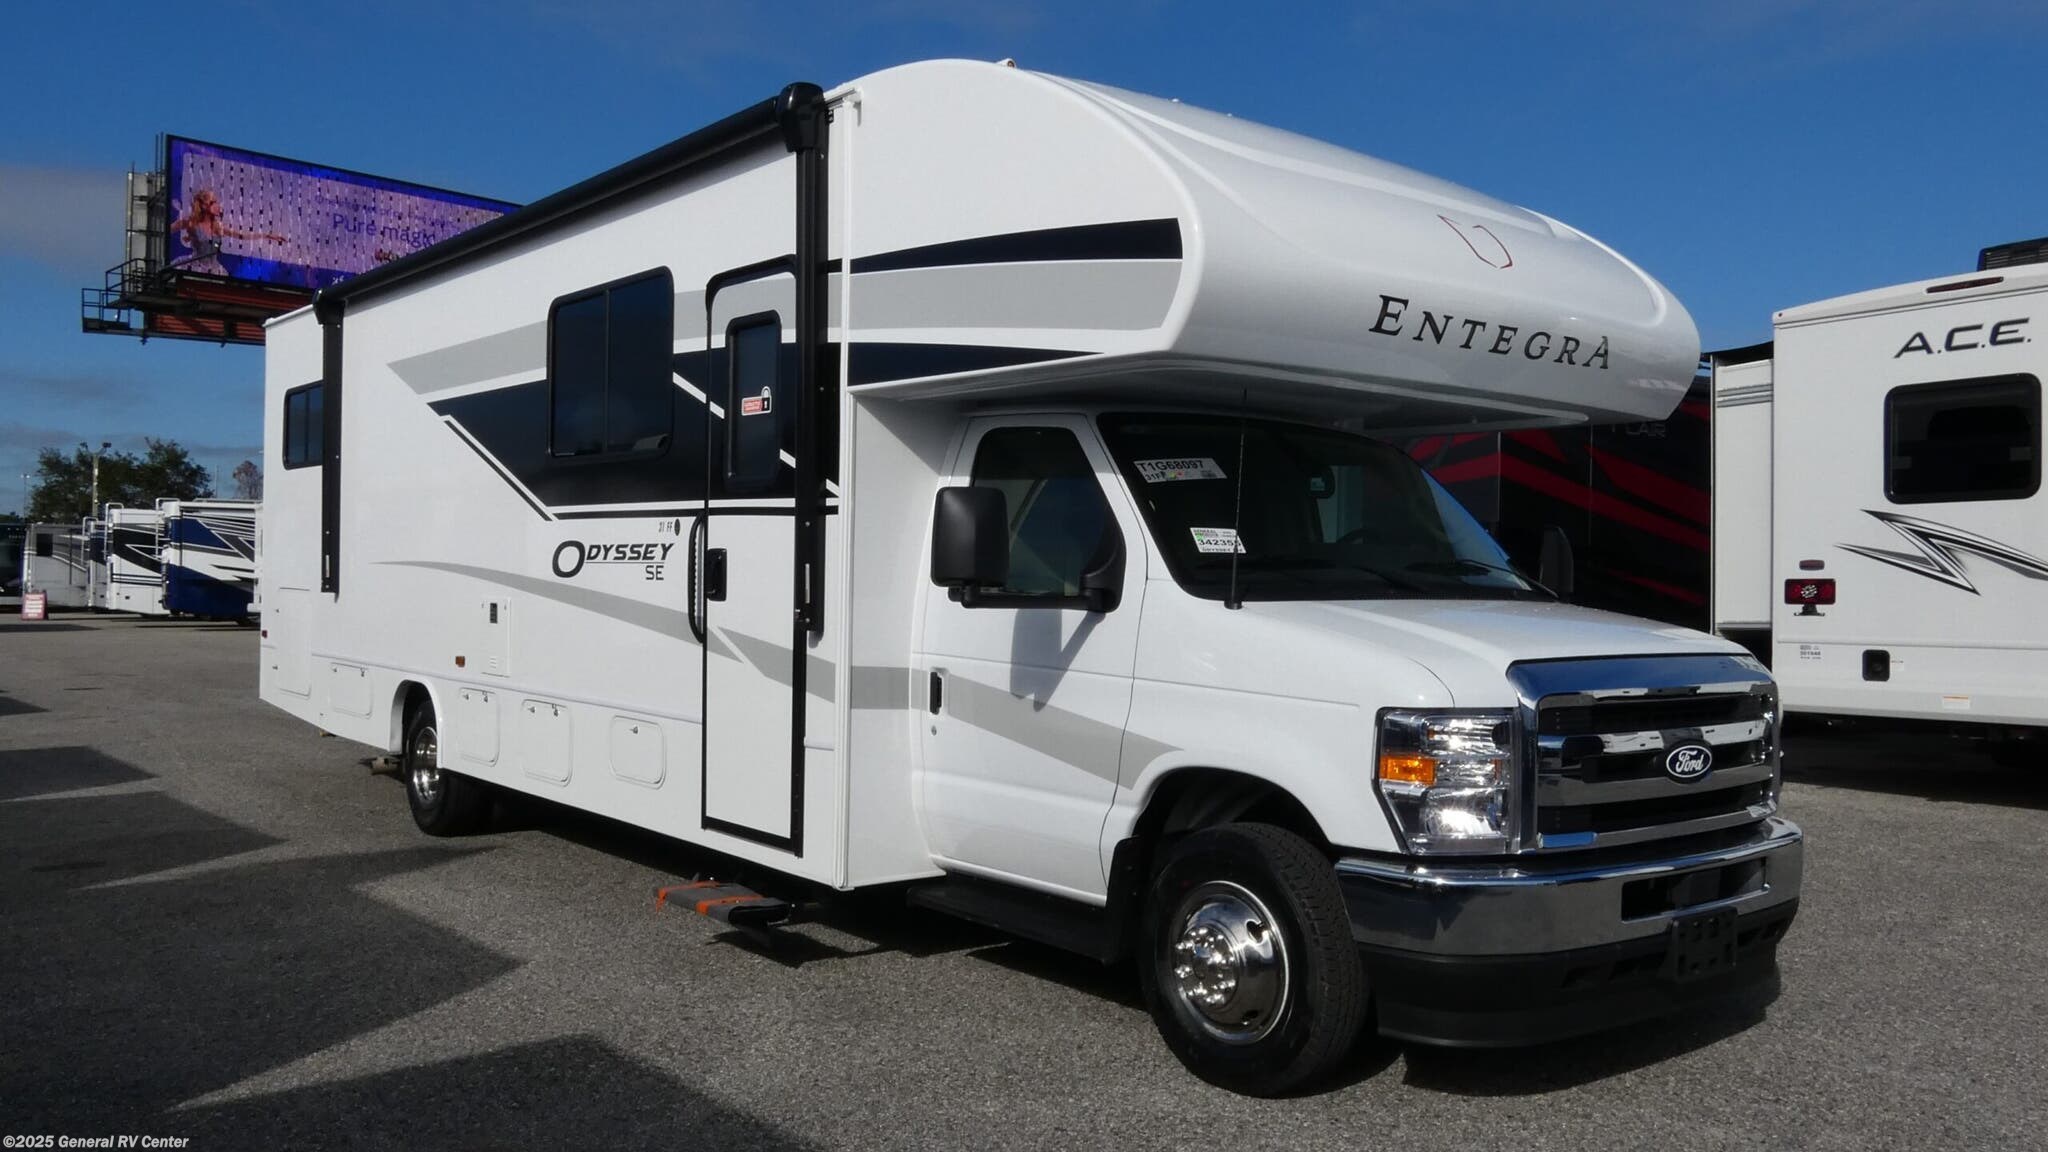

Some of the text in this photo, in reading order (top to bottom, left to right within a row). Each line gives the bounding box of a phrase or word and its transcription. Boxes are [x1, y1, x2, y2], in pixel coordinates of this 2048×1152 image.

[332, 212, 377, 237] Pure
[1368, 294, 1610, 370] ENTEGRA
[1893, 317, 2032, 359] A.C.E.
[552, 540, 675, 578] ODYSSEY
[645, 565, 664, 580] SE
[1676, 750, 1704, 773] Ford
